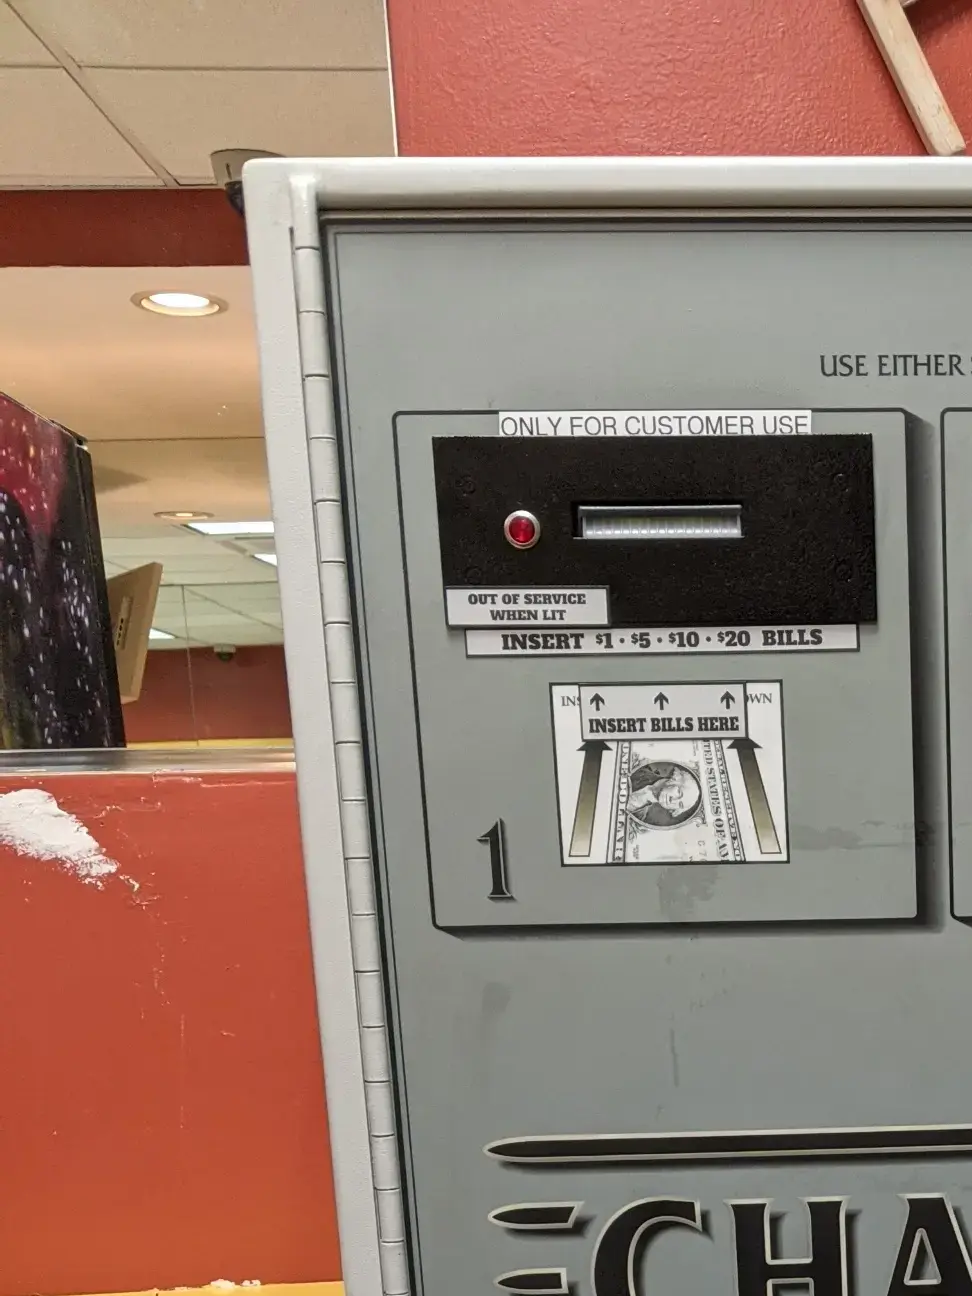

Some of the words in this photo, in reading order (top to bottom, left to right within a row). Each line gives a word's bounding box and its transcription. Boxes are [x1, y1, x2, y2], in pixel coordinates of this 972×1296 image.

[820, 354, 868, 377] USE
[878, 354, 966, 377] EITHER
[501, 416, 562, 436] ONLY
[570, 416, 617, 436] FOR
[624, 416, 754, 435] CUSTOMER
[763, 415, 808, 435] USE
[468, 593, 494, 606] OUT
[498, 593, 521, 606] OF
[523, 592, 587, 605] SERVICE
[490, 609, 538, 621] WHEN
[541, 609, 567, 621] LIT
[501, 632, 584, 651] INSERT
[595, 632, 614, 650] $1
[631, 631, 651, 649] $5
[668, 631, 700, 649] $10
[717, 630, 751, 648] $20
[761, 628, 823, 647] BILLS
[747, 692, 773, 705] WN
[589, 717, 647, 733] INSERT
[650, 717, 694, 732] BILLS
[698, 715, 740, 731] HERE
[476, 818, 515, 901] 1
